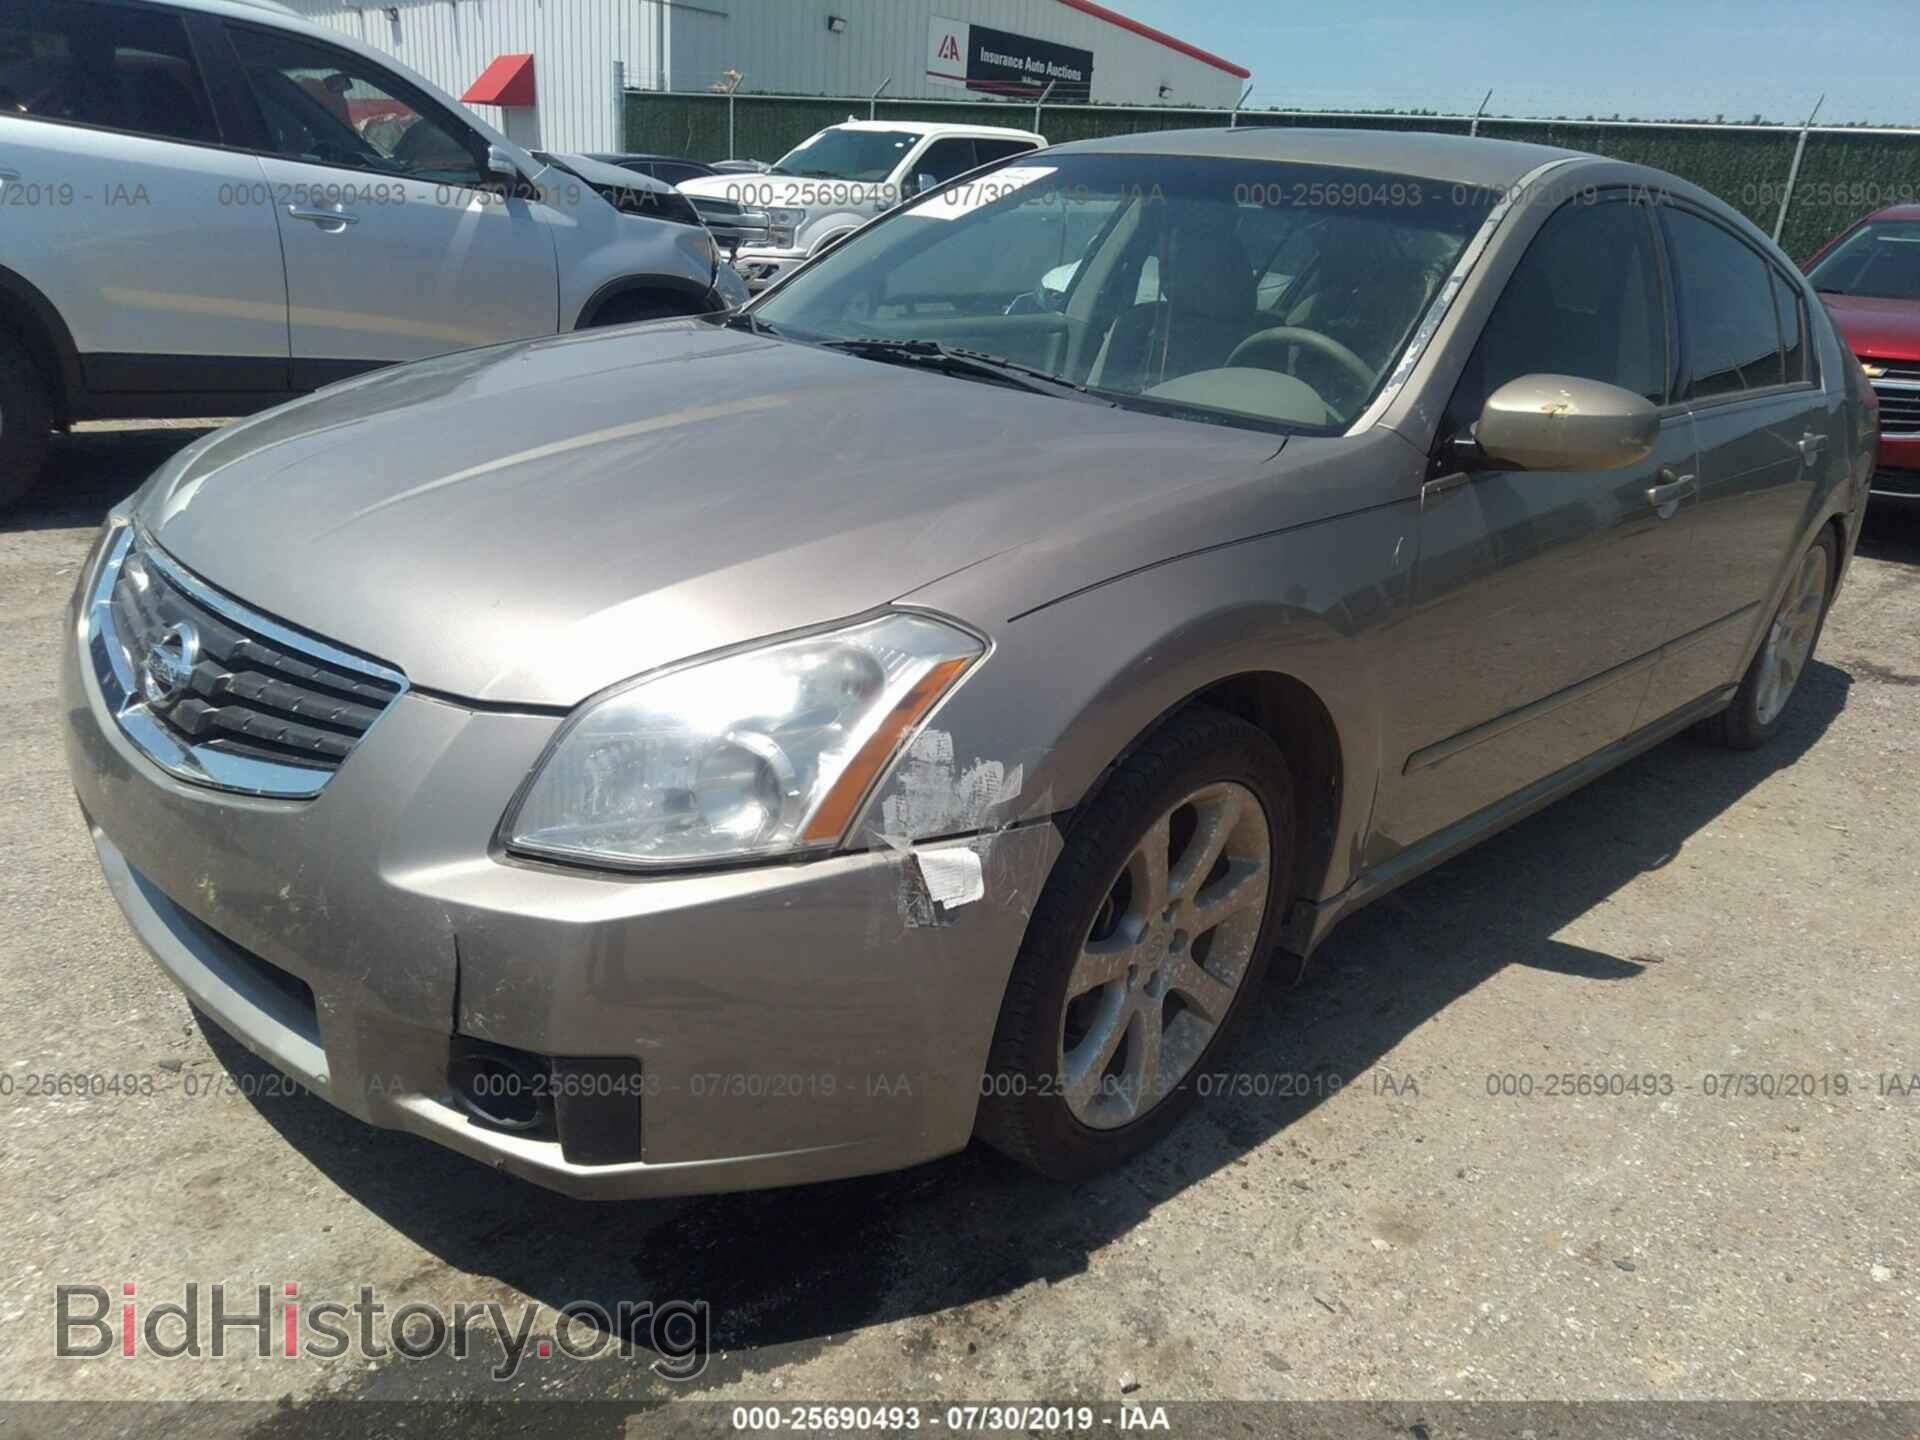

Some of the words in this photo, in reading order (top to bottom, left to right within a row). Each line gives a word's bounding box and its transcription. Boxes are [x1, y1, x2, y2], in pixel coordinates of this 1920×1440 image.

[980, 46, 1024, 69] Insurance
[1024, 56, 1046, 74] Auto
[1046, 61, 1081, 80] Auctions
